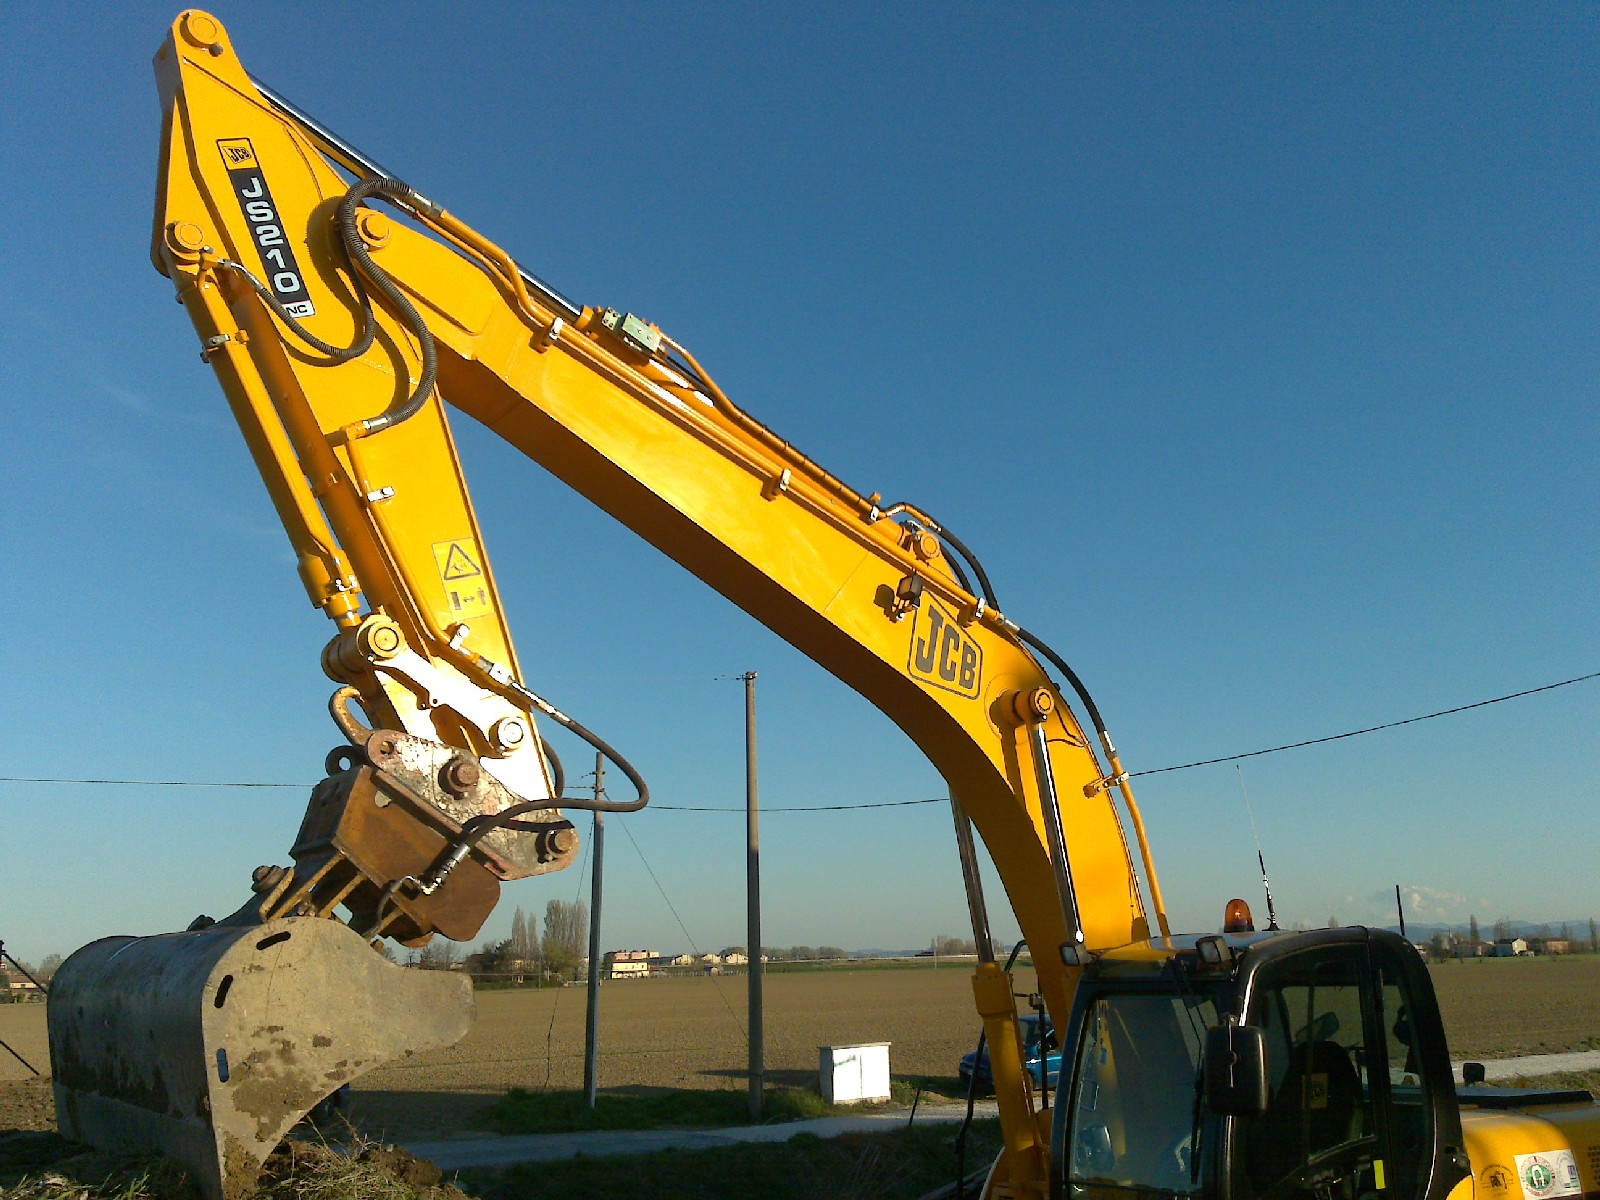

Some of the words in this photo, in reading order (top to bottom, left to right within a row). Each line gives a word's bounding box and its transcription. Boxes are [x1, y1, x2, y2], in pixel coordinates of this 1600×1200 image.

[227, 147, 251, 163] JCB
[241, 177, 301, 293] JS210
[286, 304, 308, 314] NC
[915, 604, 977, 690] JCB
